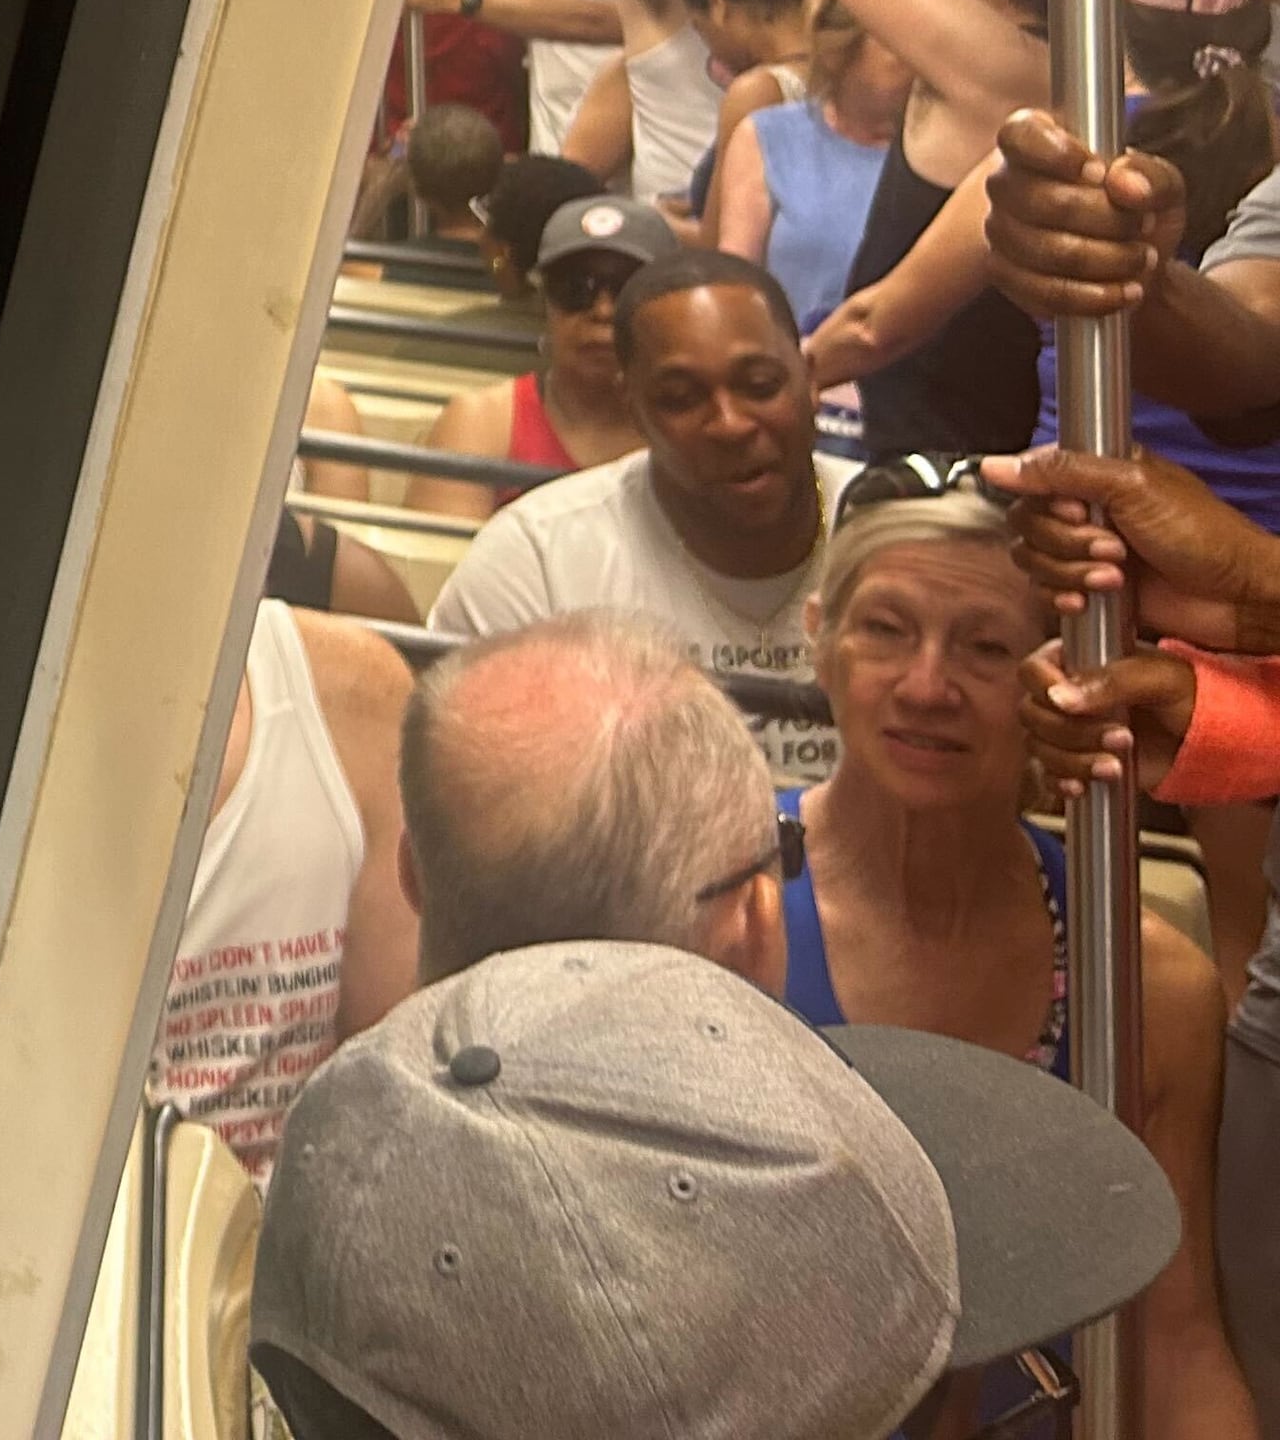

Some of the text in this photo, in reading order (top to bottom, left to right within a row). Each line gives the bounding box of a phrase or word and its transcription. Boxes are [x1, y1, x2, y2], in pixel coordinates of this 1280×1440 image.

[174, 957, 203, 981] OU
[278, 931, 329, 961] HAVE
[267, 961, 339, 995] BUNGHO
